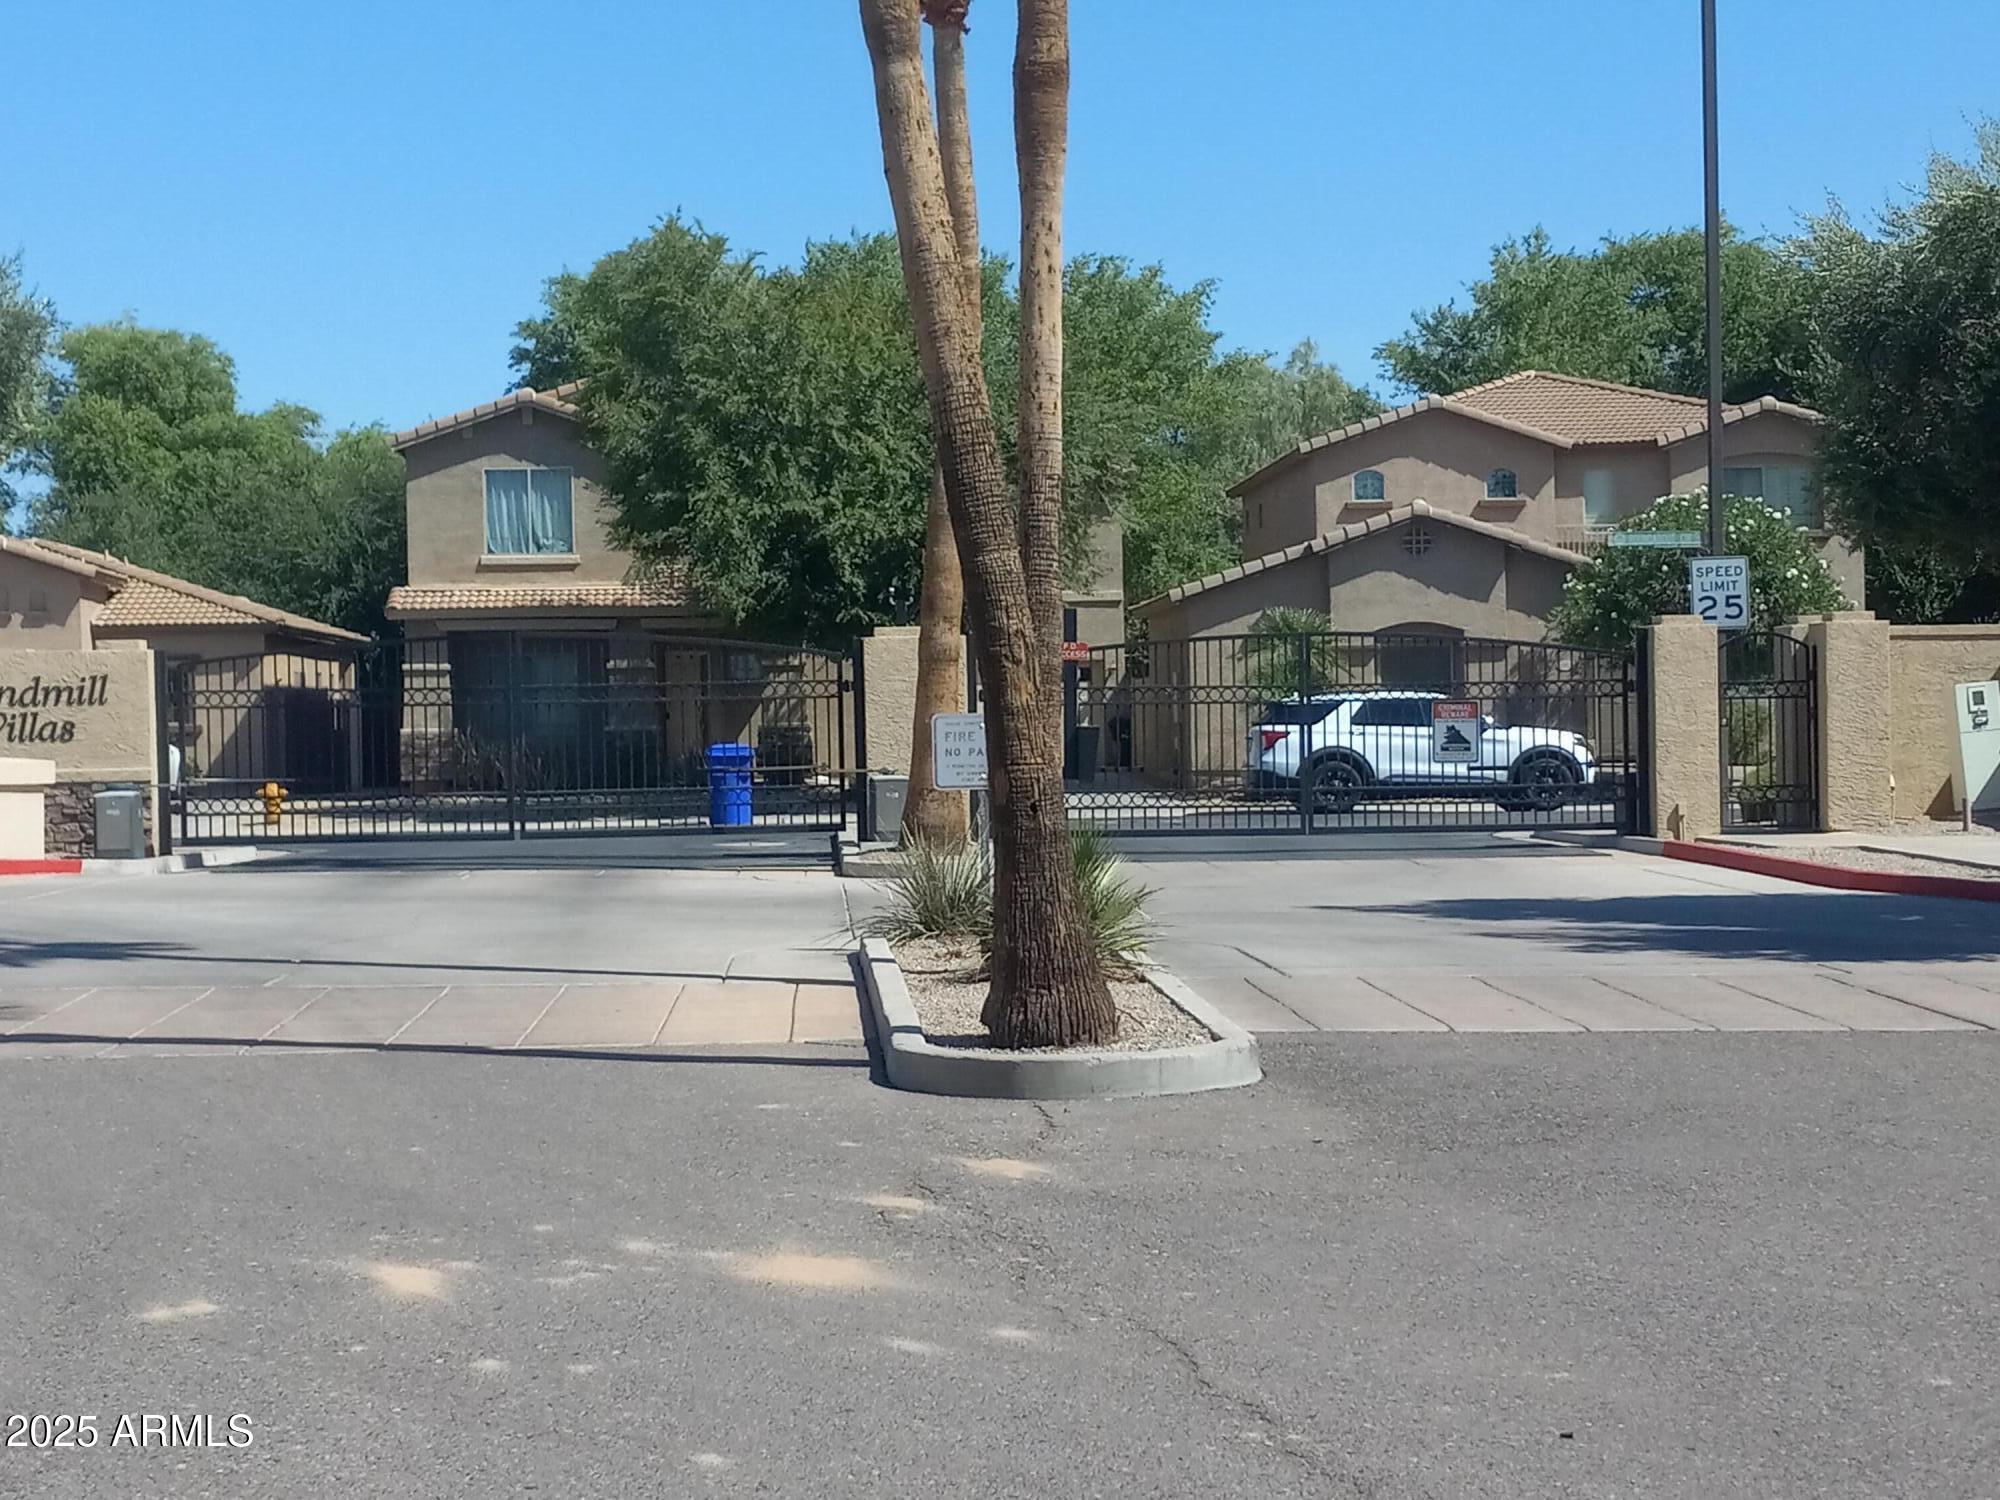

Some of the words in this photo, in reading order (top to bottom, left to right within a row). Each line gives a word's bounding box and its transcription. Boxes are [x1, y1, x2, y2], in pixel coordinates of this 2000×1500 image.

[1696, 566, 1743, 578] SPEED
[1701, 580, 1739, 592] LIMIT
[1698, 595, 1743, 620] 25
[945, 731, 976, 742] FIRE
[945, 748, 961, 757] NO
